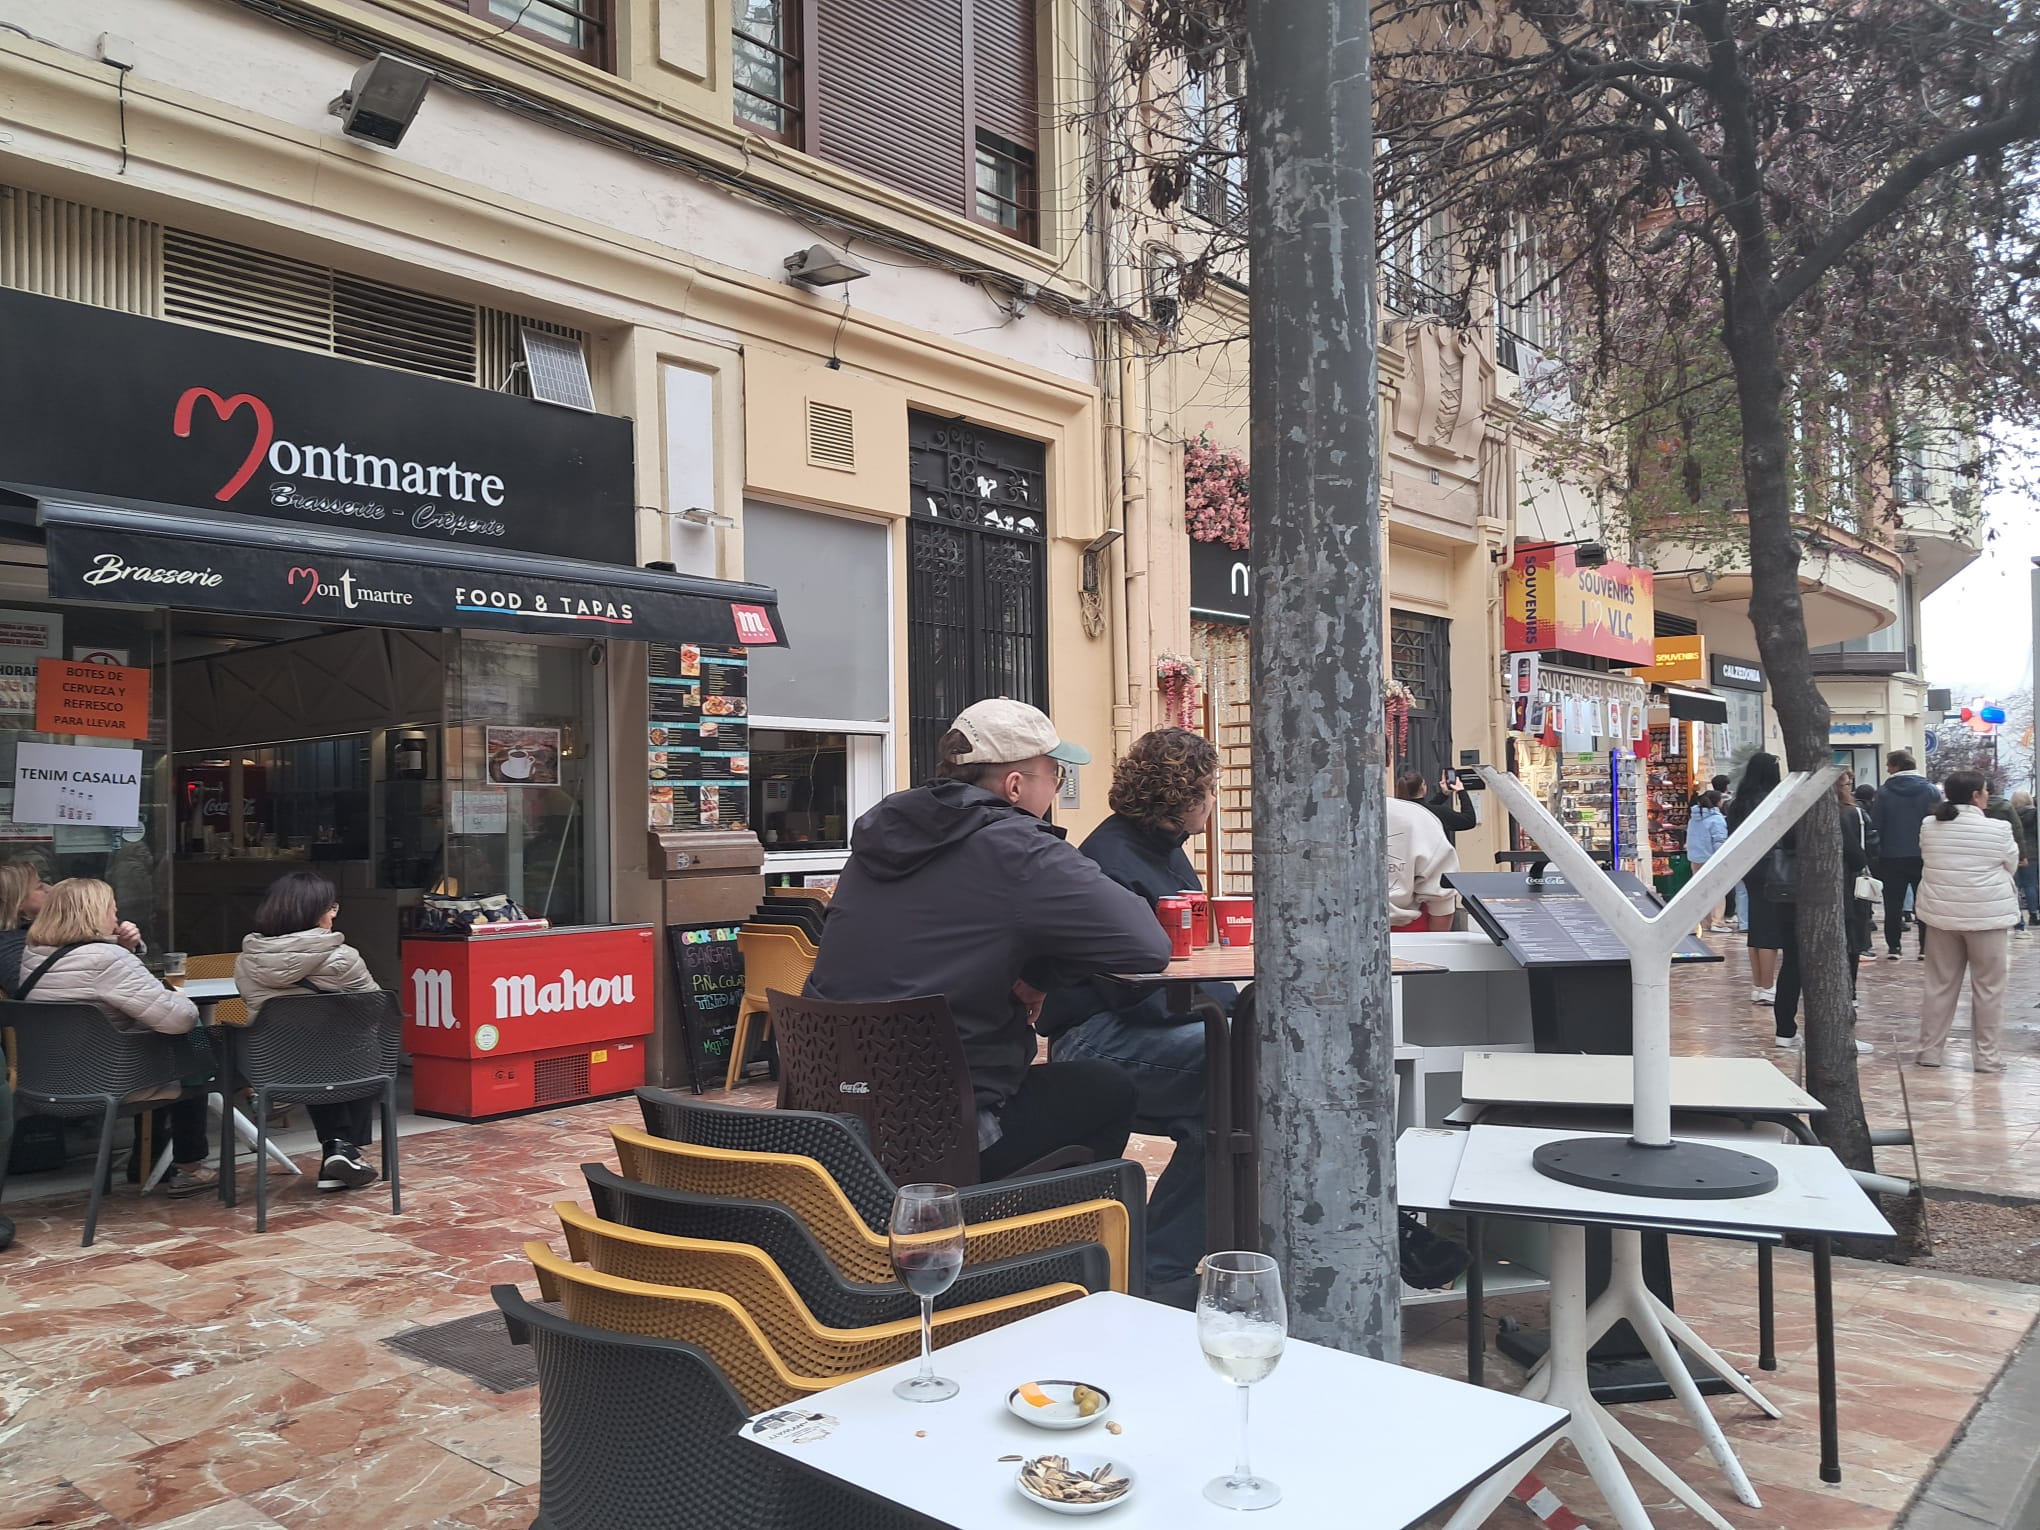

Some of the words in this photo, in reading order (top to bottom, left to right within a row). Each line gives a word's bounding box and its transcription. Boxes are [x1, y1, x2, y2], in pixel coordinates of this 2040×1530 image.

[268, 482, 386, 520] Brasserie
[82, 553, 224, 588] Brasserie
[1578, 571, 1635, 606] SOUVENIRS
[455, 587, 522, 610] FOOD
[535, 595, 548, 612] &
[560, 597, 633, 619] TAPAS
[1524, 555, 1537, 645] SOUVENIRS
[1608, 607, 1634, 640] VLC
[1656, 652, 1700, 662] SOUVENIRS
[66, 667, 104, 680] BOTES
[108, 670, 123, 682] DE
[1722, 664, 1761, 682] CALZEDONIA
[63, 682, 116, 697] CERVEZA
[119, 687, 126, 697] Y
[1606, 682, 1643, 702] SALERO
[64, 698, 124, 712] REFRESCO
[54, 715, 83, 727] PARA
[87, 718, 126, 729] LLEVAR
[20, 768, 68, 782] TENIM
[72, 771, 137, 785] CASALLA
[491, 968, 636, 1019] Mahou
